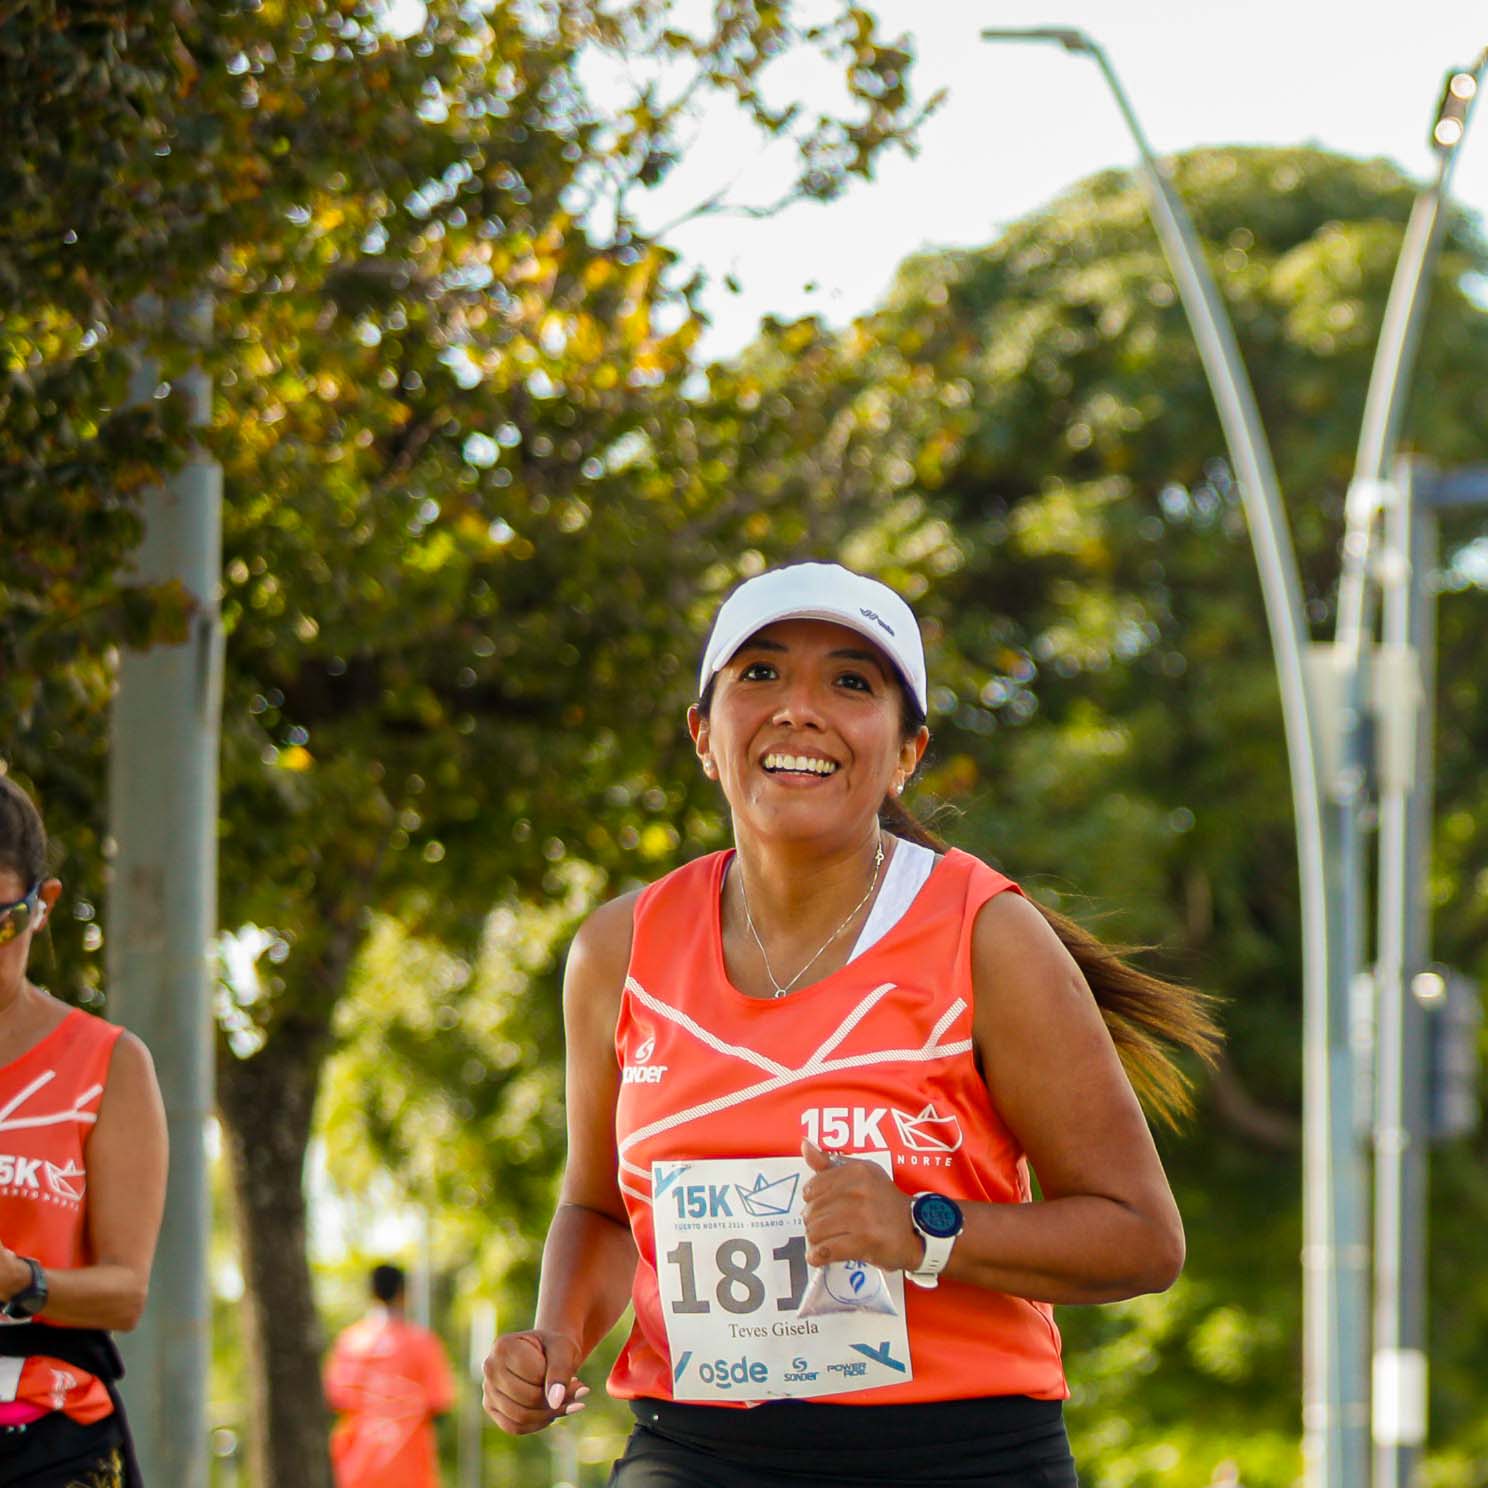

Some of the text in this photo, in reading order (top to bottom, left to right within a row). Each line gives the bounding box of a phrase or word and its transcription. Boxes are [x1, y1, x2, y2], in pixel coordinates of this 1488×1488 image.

[801, 1106, 889, 1149] 15K
[0, 1154, 43, 1188] 5K
[897, 1155, 953, 1168] NORTE
[671, 1184, 734, 1219] 15K
[666, 1236, 809, 1314] 181
[728, 1321, 819, 1338] Teves Gisela
[699, 1356, 769, 1388] osde
